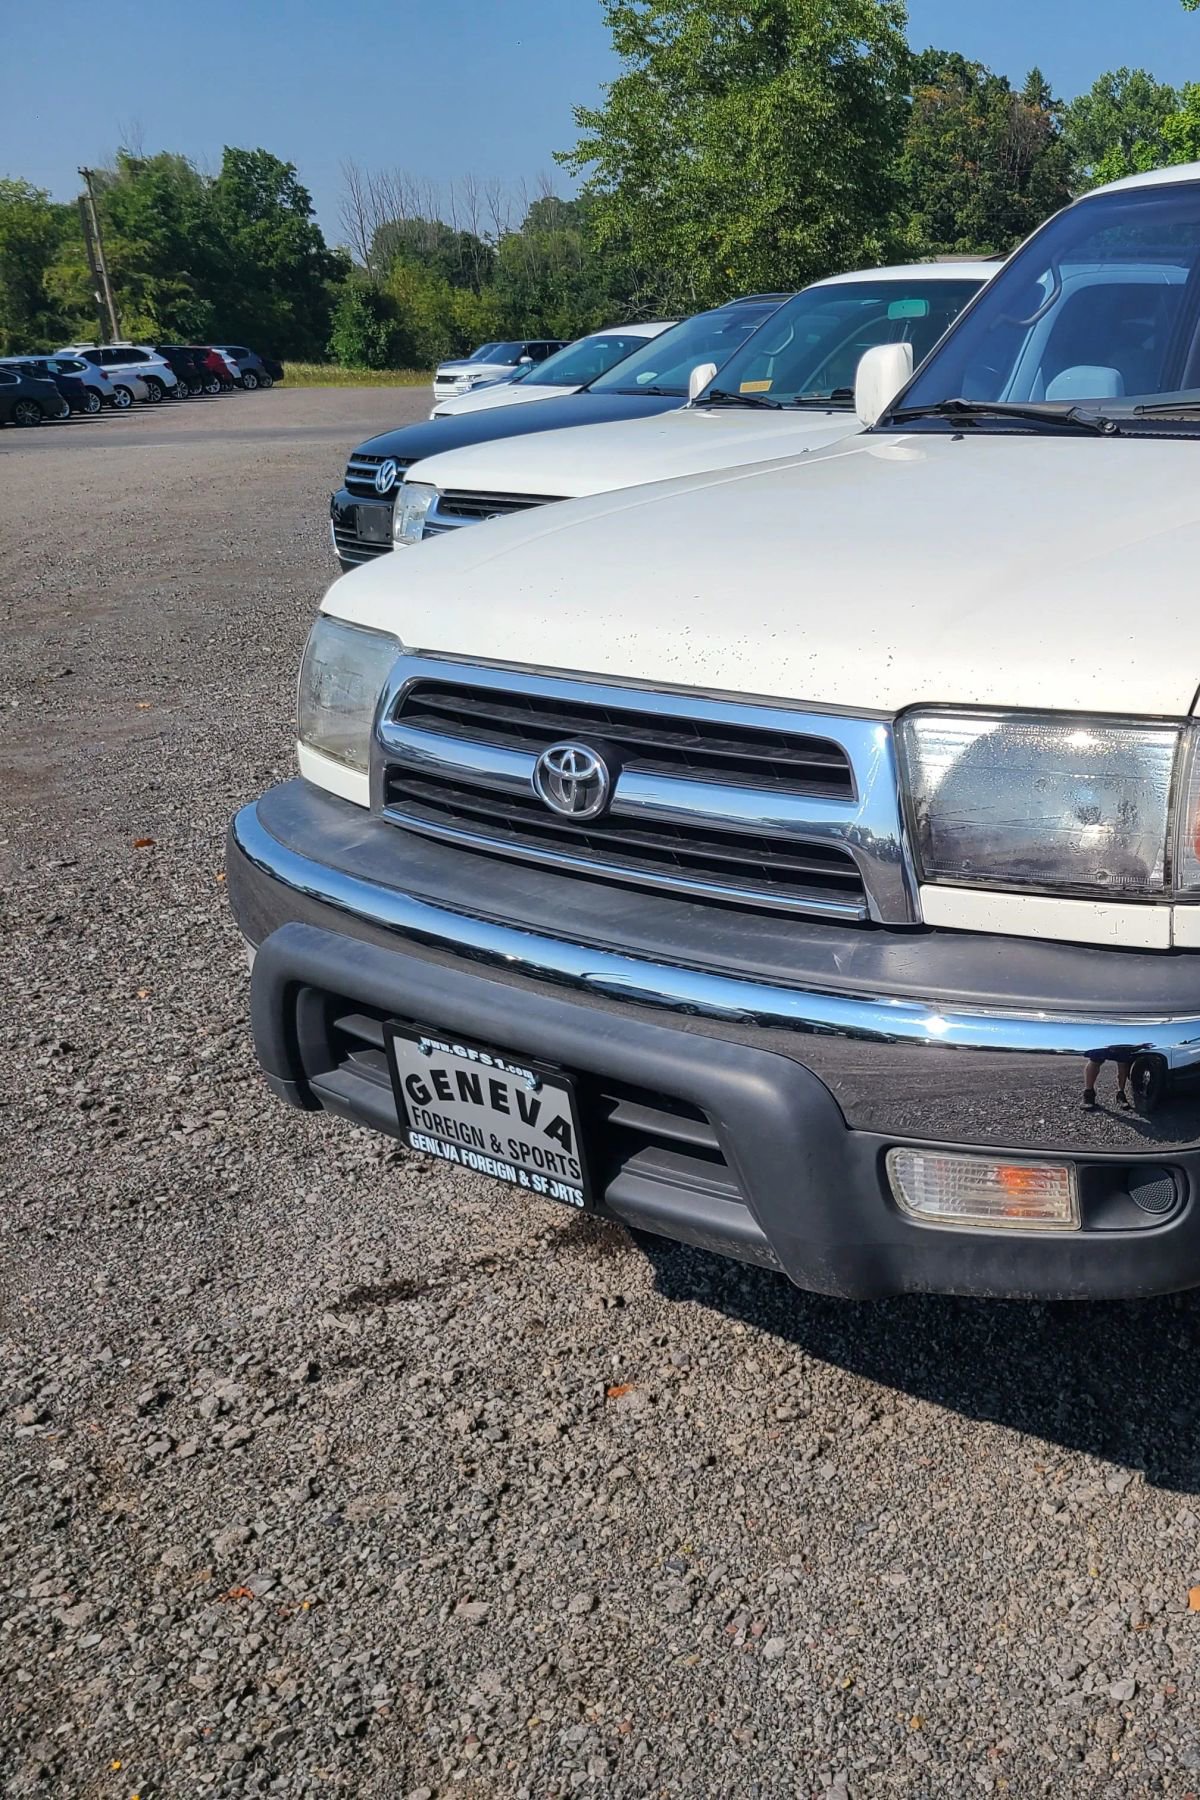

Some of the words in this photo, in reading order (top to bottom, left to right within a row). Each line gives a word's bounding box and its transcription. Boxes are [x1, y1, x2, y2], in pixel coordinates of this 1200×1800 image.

[419, 1036, 534, 1079] www.GFS1.com
[405, 1069, 573, 1154] GENEVA
[411, 1105, 485, 1150] FOREIGN
[490, 1132, 504, 1155] &
[507, 1138, 582, 1180] SPORTS
[460, 1148, 517, 1184] FOREIGN
[518, 1169, 532, 1188] &
